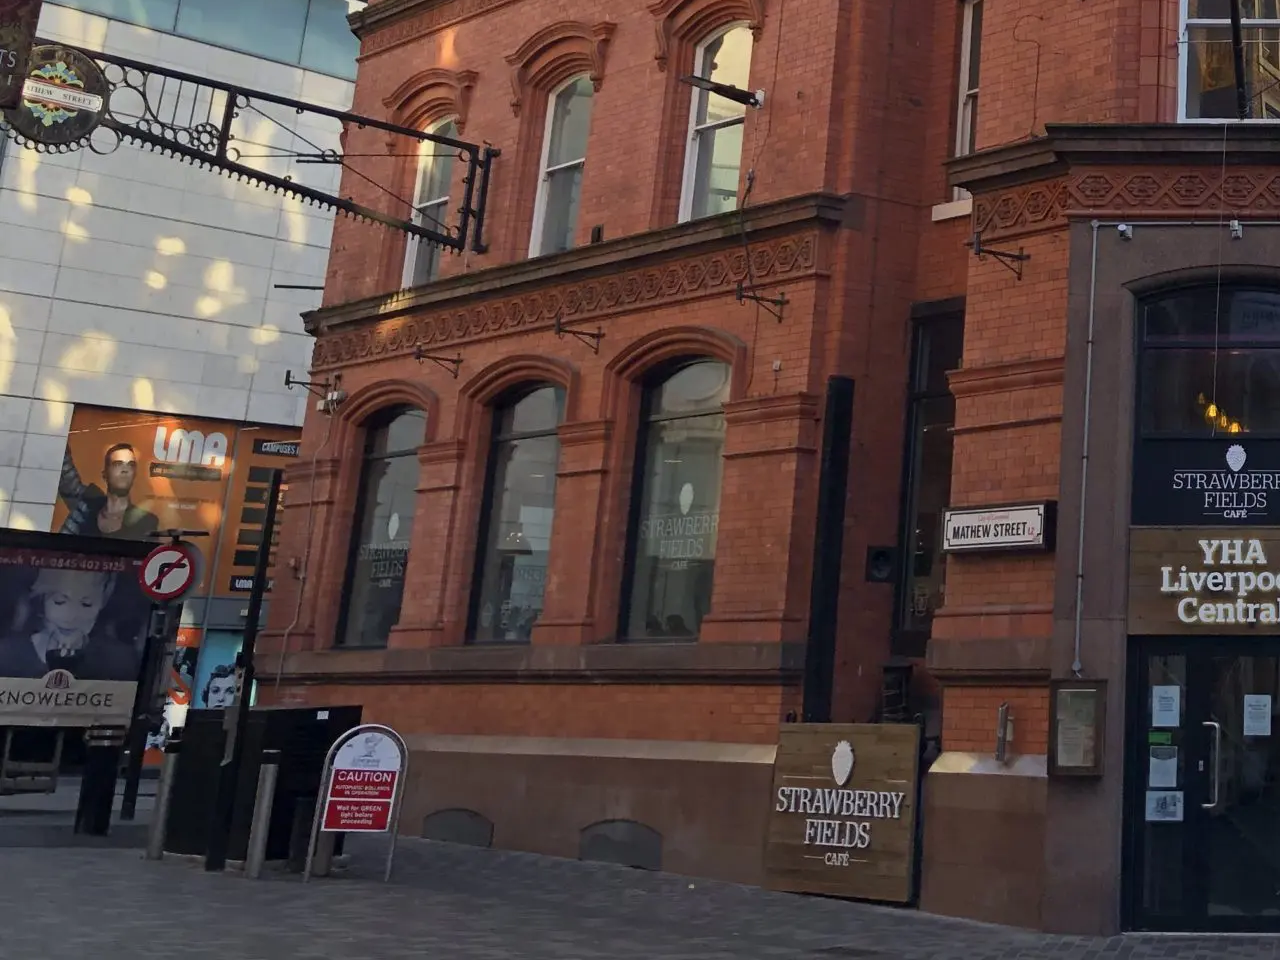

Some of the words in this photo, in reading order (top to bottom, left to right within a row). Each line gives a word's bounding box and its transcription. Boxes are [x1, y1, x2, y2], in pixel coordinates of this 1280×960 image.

[0, 49, 17, 68] TS
[1204, 491, 1267, 508] FIELDS
[641, 514, 719, 539] STRAWBERR
[952, 524, 992, 540] MATHEW
[993, 522, 1028, 538] STREET
[660, 537, 704, 560] FIELDS
[1198, 539, 1268, 565] YHA
[0, 691, 114, 707] KNOWLEDGE
[337, 771, 392, 782] CAUTION
[776, 786, 905, 818] STRAWBERRY
[804, 819, 870, 848] FIELDS
